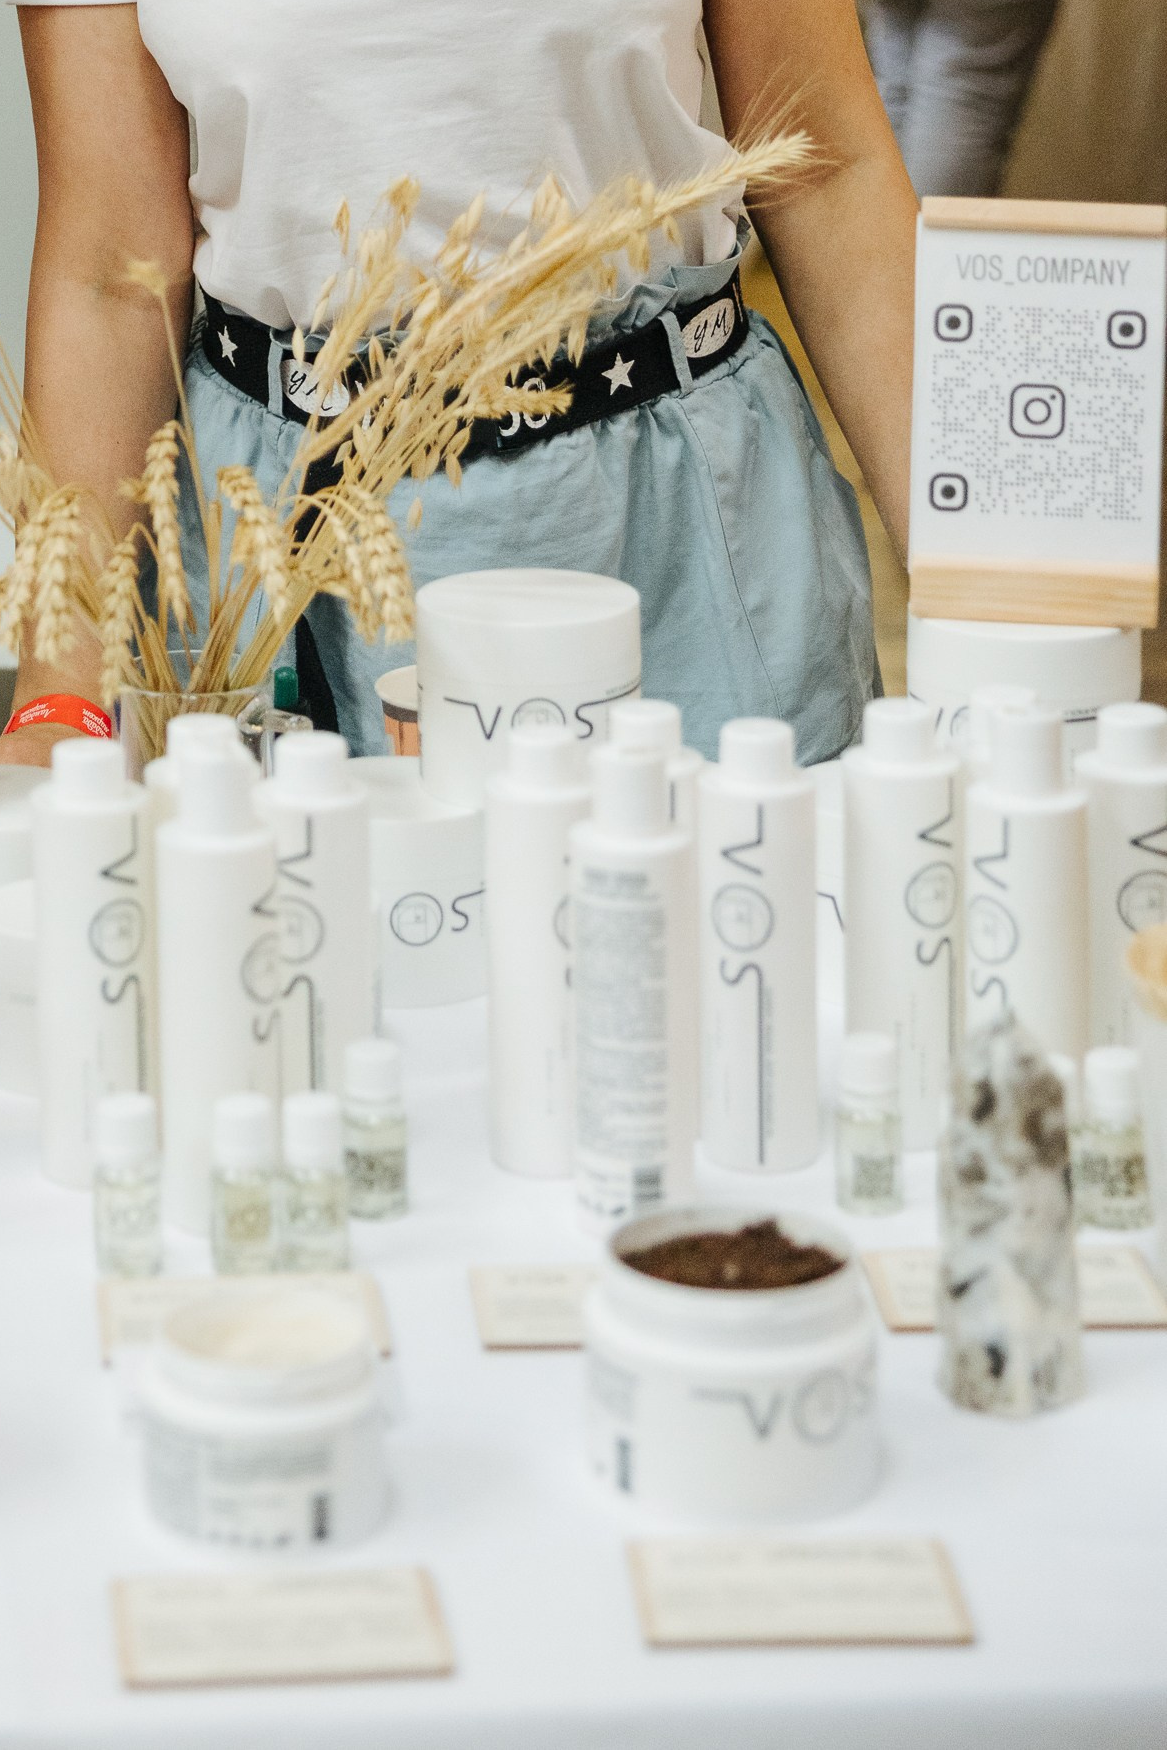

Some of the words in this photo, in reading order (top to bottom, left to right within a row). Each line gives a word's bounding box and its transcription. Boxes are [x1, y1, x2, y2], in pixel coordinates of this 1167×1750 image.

[955, 253, 1131, 287] VOS_COMPANY
[87, 814, 145, 1005] VOS
[711, 803, 774, 987] VOS
[905, 778, 956, 966] VOS
